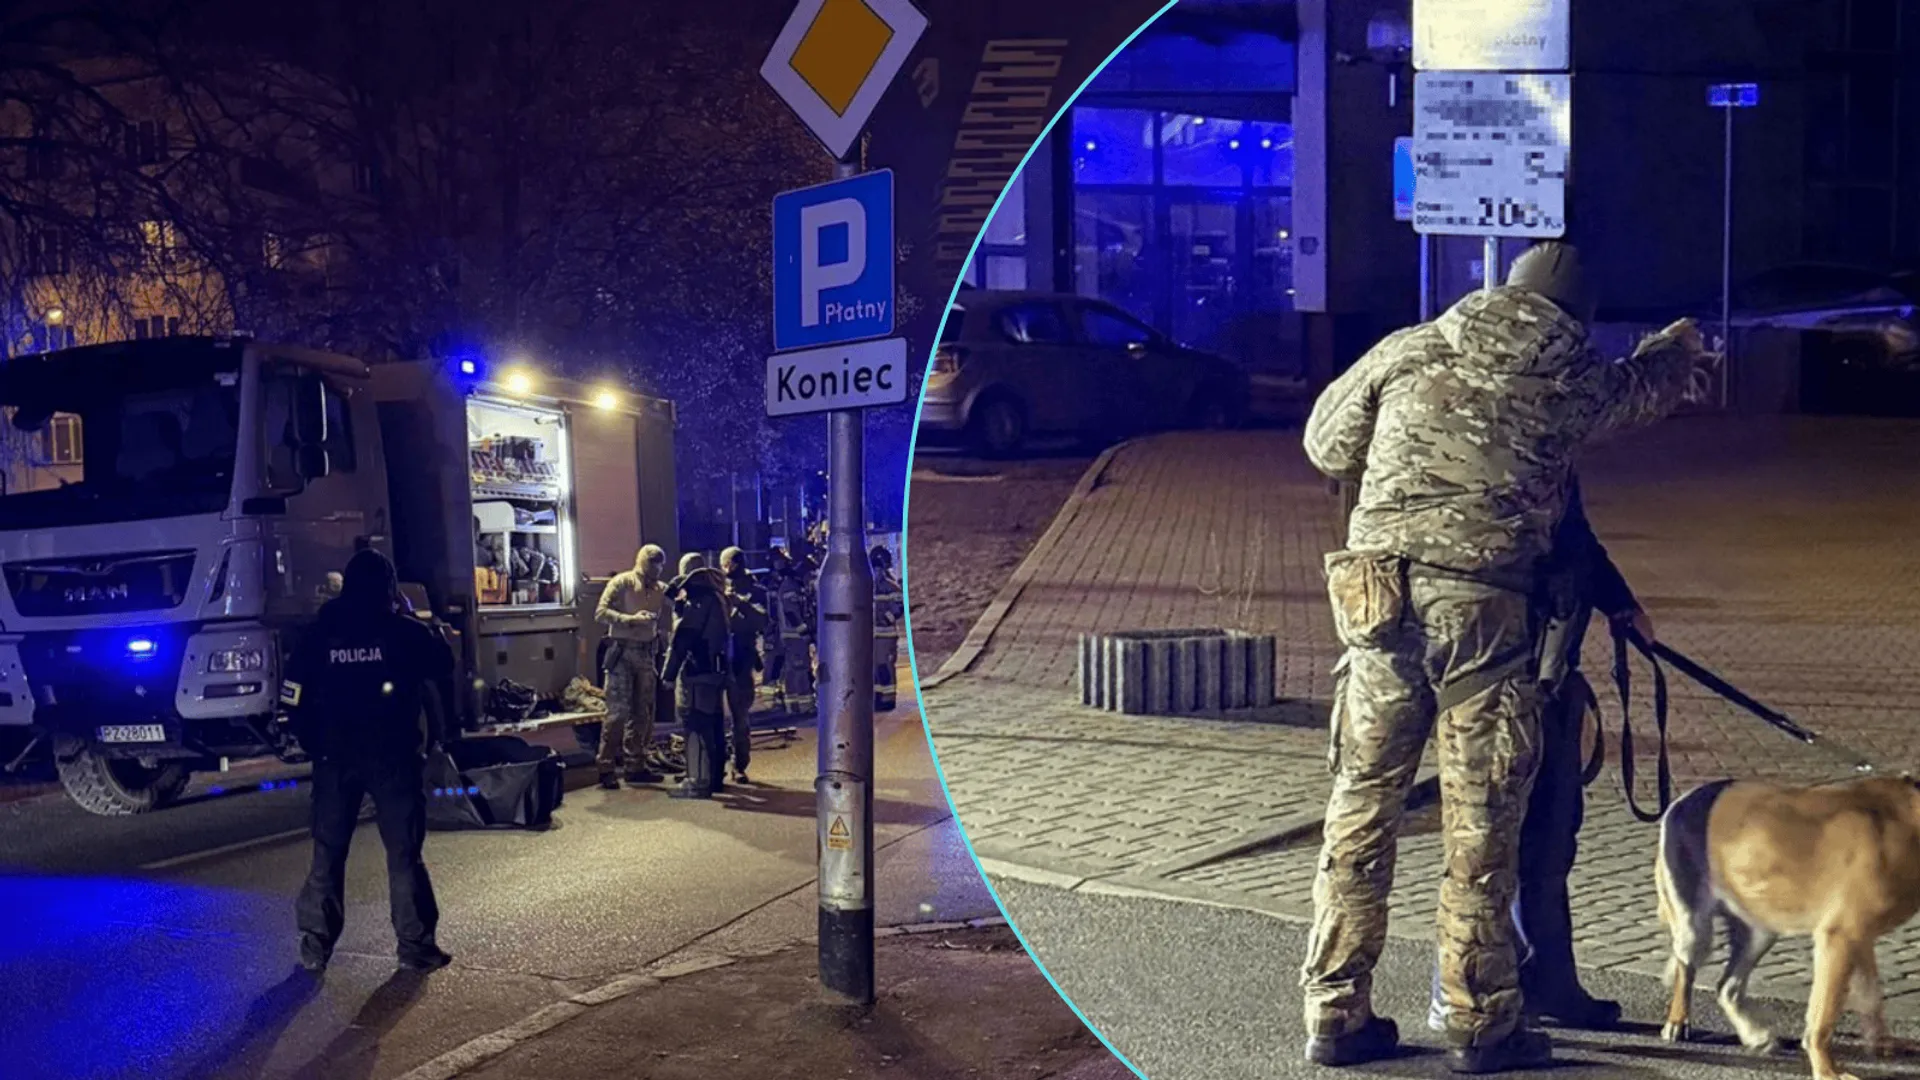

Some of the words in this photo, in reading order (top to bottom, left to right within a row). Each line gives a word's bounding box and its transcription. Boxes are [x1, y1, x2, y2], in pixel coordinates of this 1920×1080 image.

[801, 198, 867, 327] P
[825, 299, 887, 325] Płatny
[777, 357, 893, 402] Koniec
[328, 645, 384, 664] POLICJA
